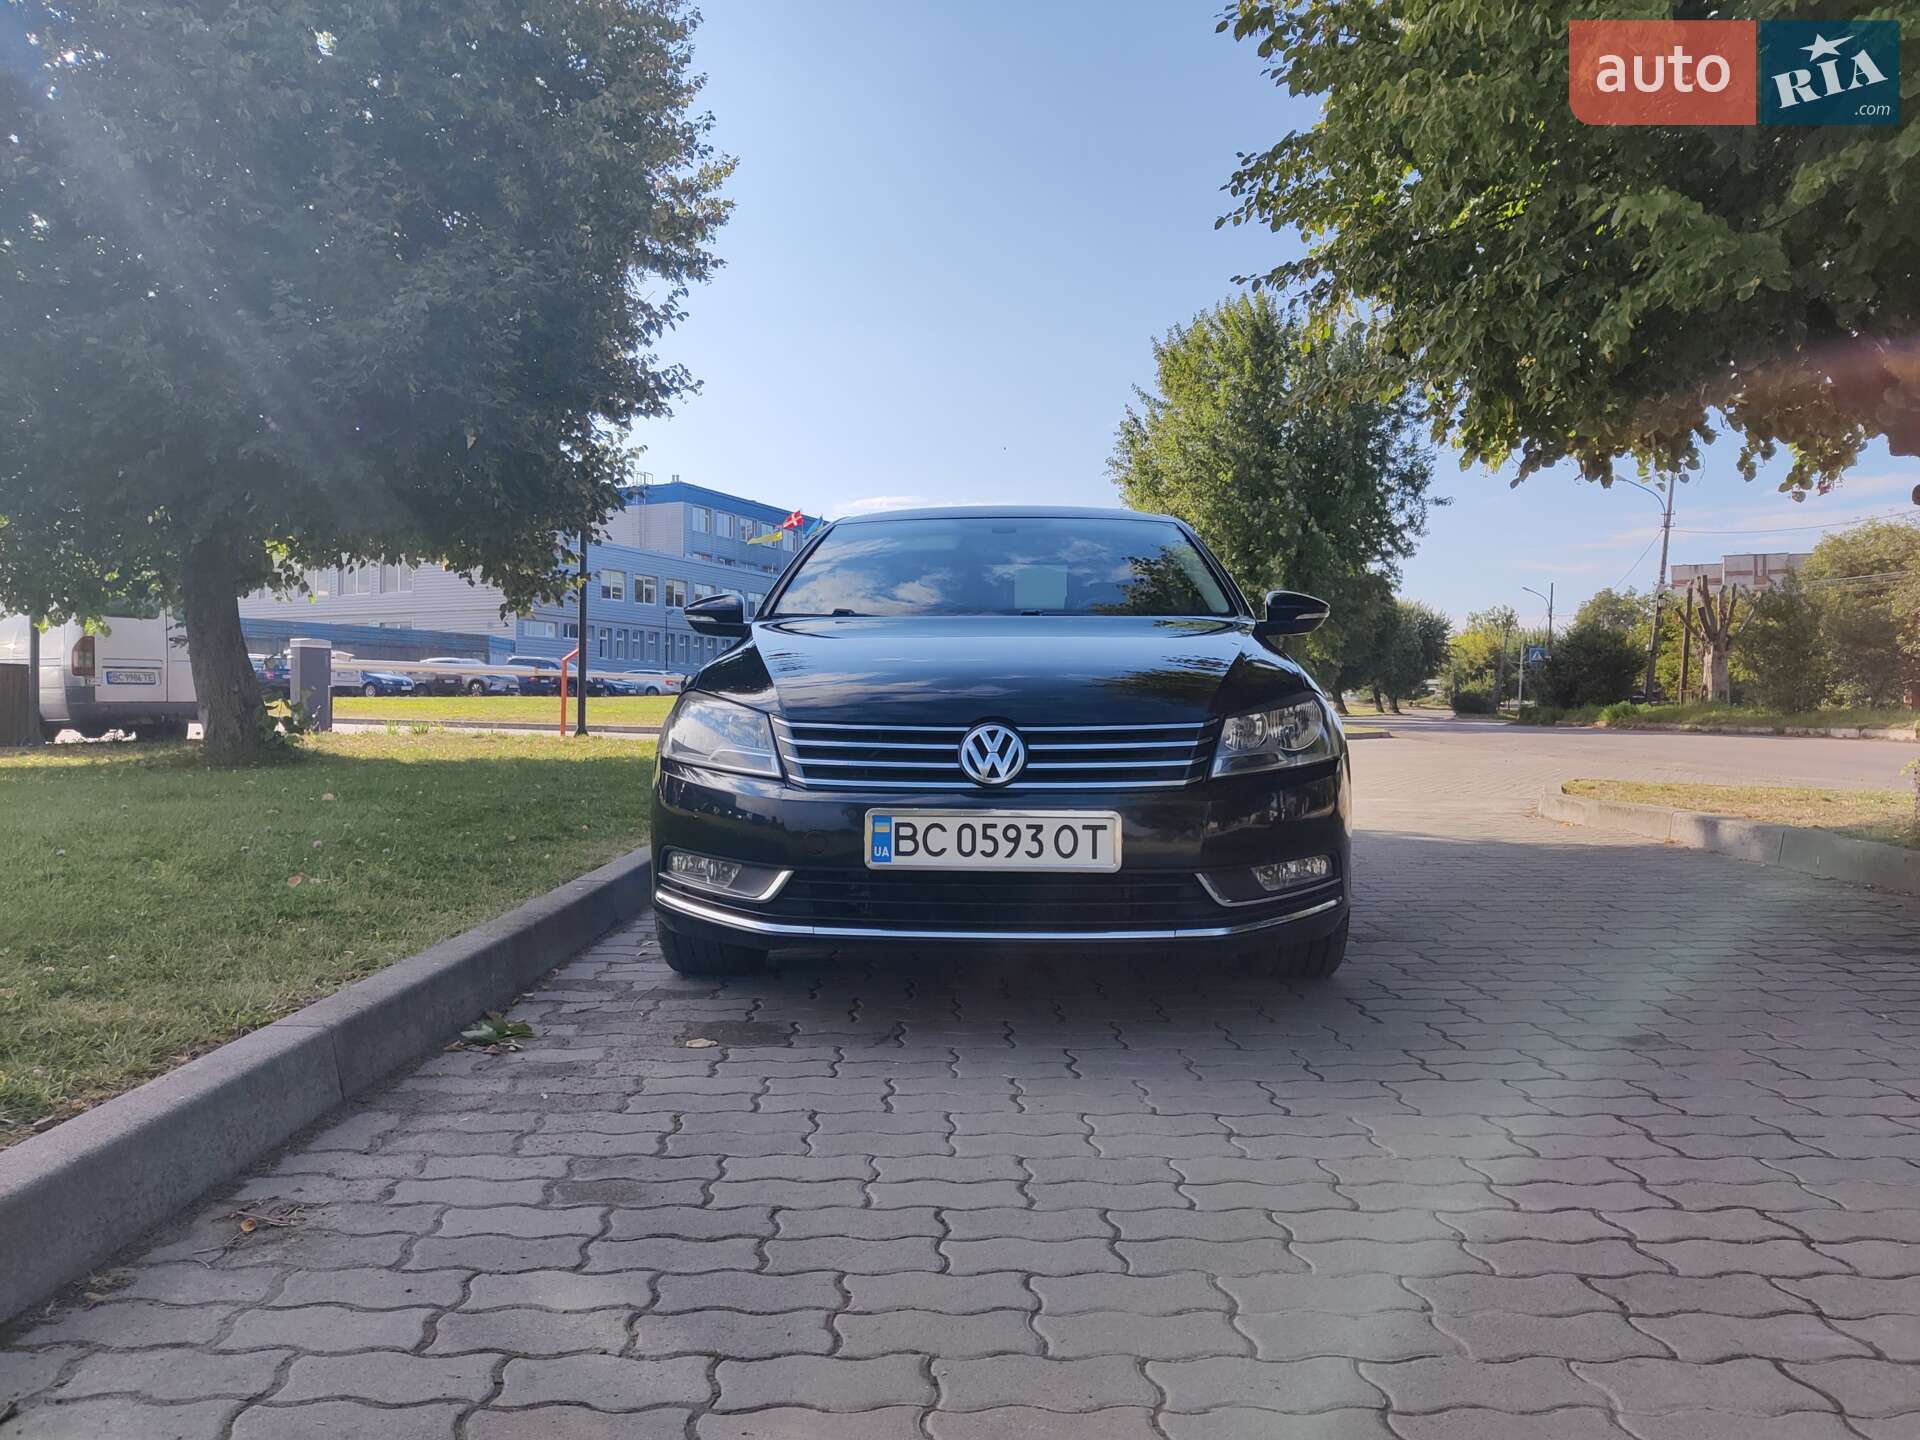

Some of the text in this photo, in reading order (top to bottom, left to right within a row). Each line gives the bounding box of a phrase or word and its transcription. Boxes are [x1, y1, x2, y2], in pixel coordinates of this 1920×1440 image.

[874, 846, 890, 858] UA
[894, 822, 1108, 860] BC 0593 OT
